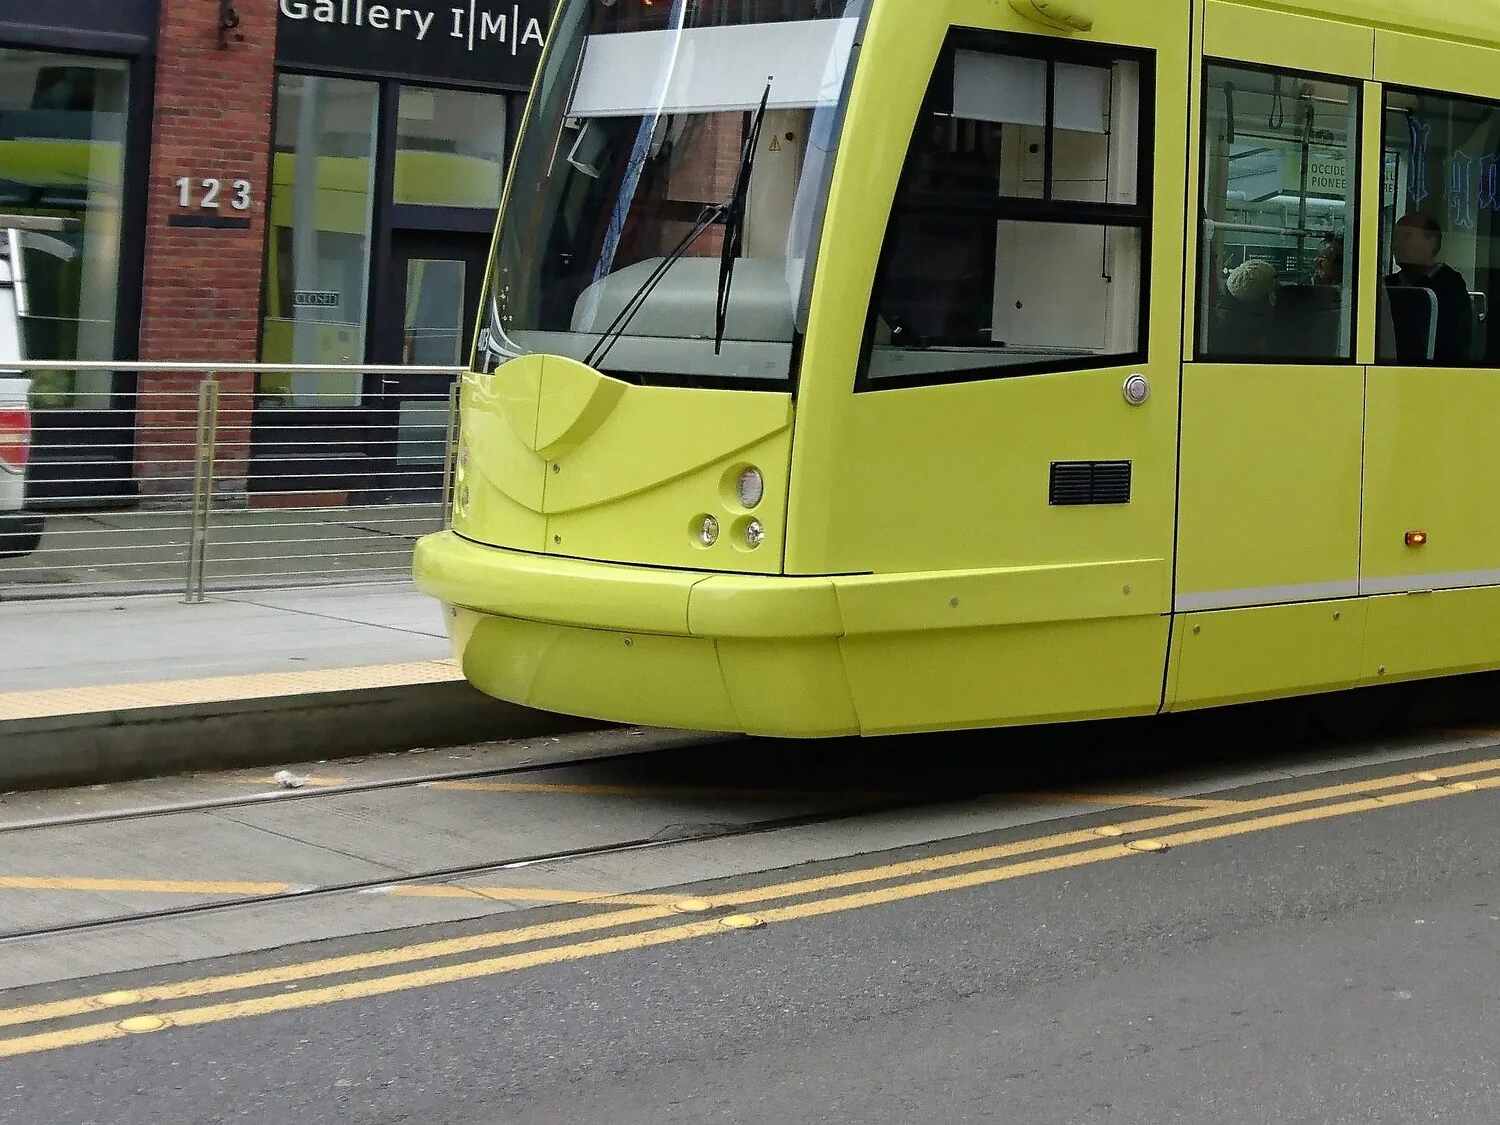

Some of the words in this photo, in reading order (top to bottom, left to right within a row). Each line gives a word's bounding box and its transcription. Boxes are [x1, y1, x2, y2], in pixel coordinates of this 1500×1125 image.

[1311, 163, 1345, 176] OCCIDE
[1311, 176, 1347, 189] PIONEE
[175, 176, 251, 210] 123
[295, 293, 338, 306] CLOSED
